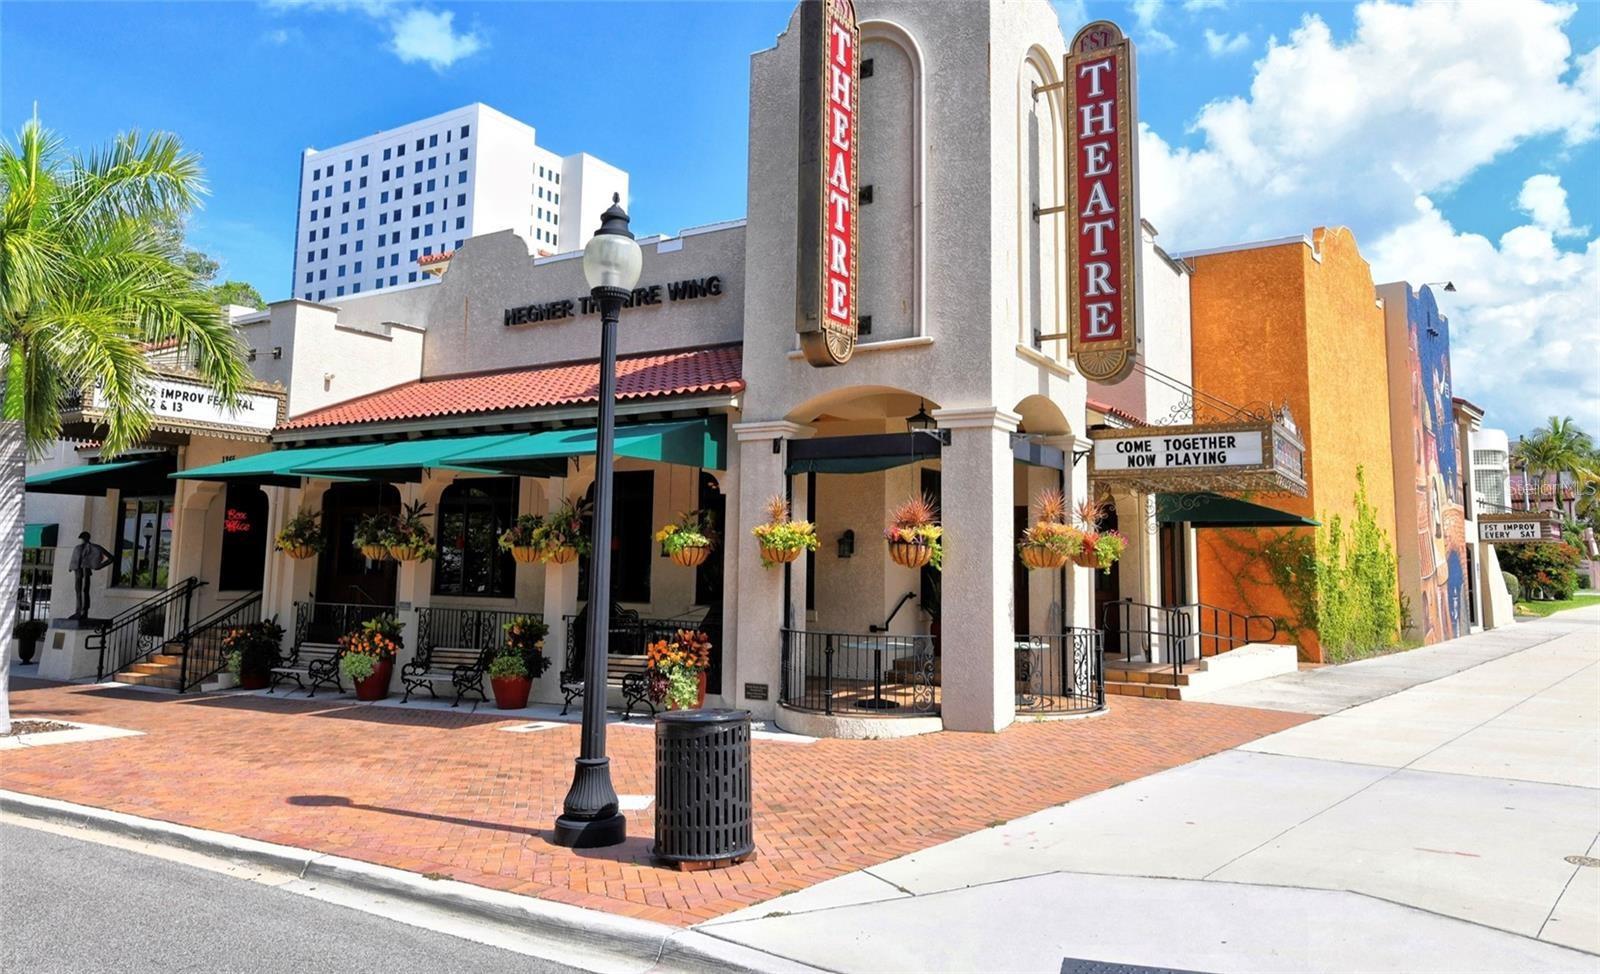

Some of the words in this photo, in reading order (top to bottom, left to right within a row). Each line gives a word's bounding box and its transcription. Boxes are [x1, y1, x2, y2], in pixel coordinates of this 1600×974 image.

[830, 22, 851, 321] THEATRE
[1079, 60, 1117, 338] THEATRE
[504, 300, 575, 326] HEGNER
[578, 285, 662, 315] THTRE
[667, 276, 722, 301] WING
[160, 388, 204, 404] IMPROV
[160, 400, 168, 411] &
[172, 401, 183, 412] 13
[1116, 440, 1152, 453] COME
[1164, 436, 1236, 451] TOGETHER
[1127, 453, 1156, 467] NOW
[1165, 451, 1227, 466] PLAYING
[227, 508, 247, 520] Box
[1485, 531, 1511, 539] EVERY
[1520, 530, 1535, 538] SAT
[1503, 523, 1535, 531] IMPROV
